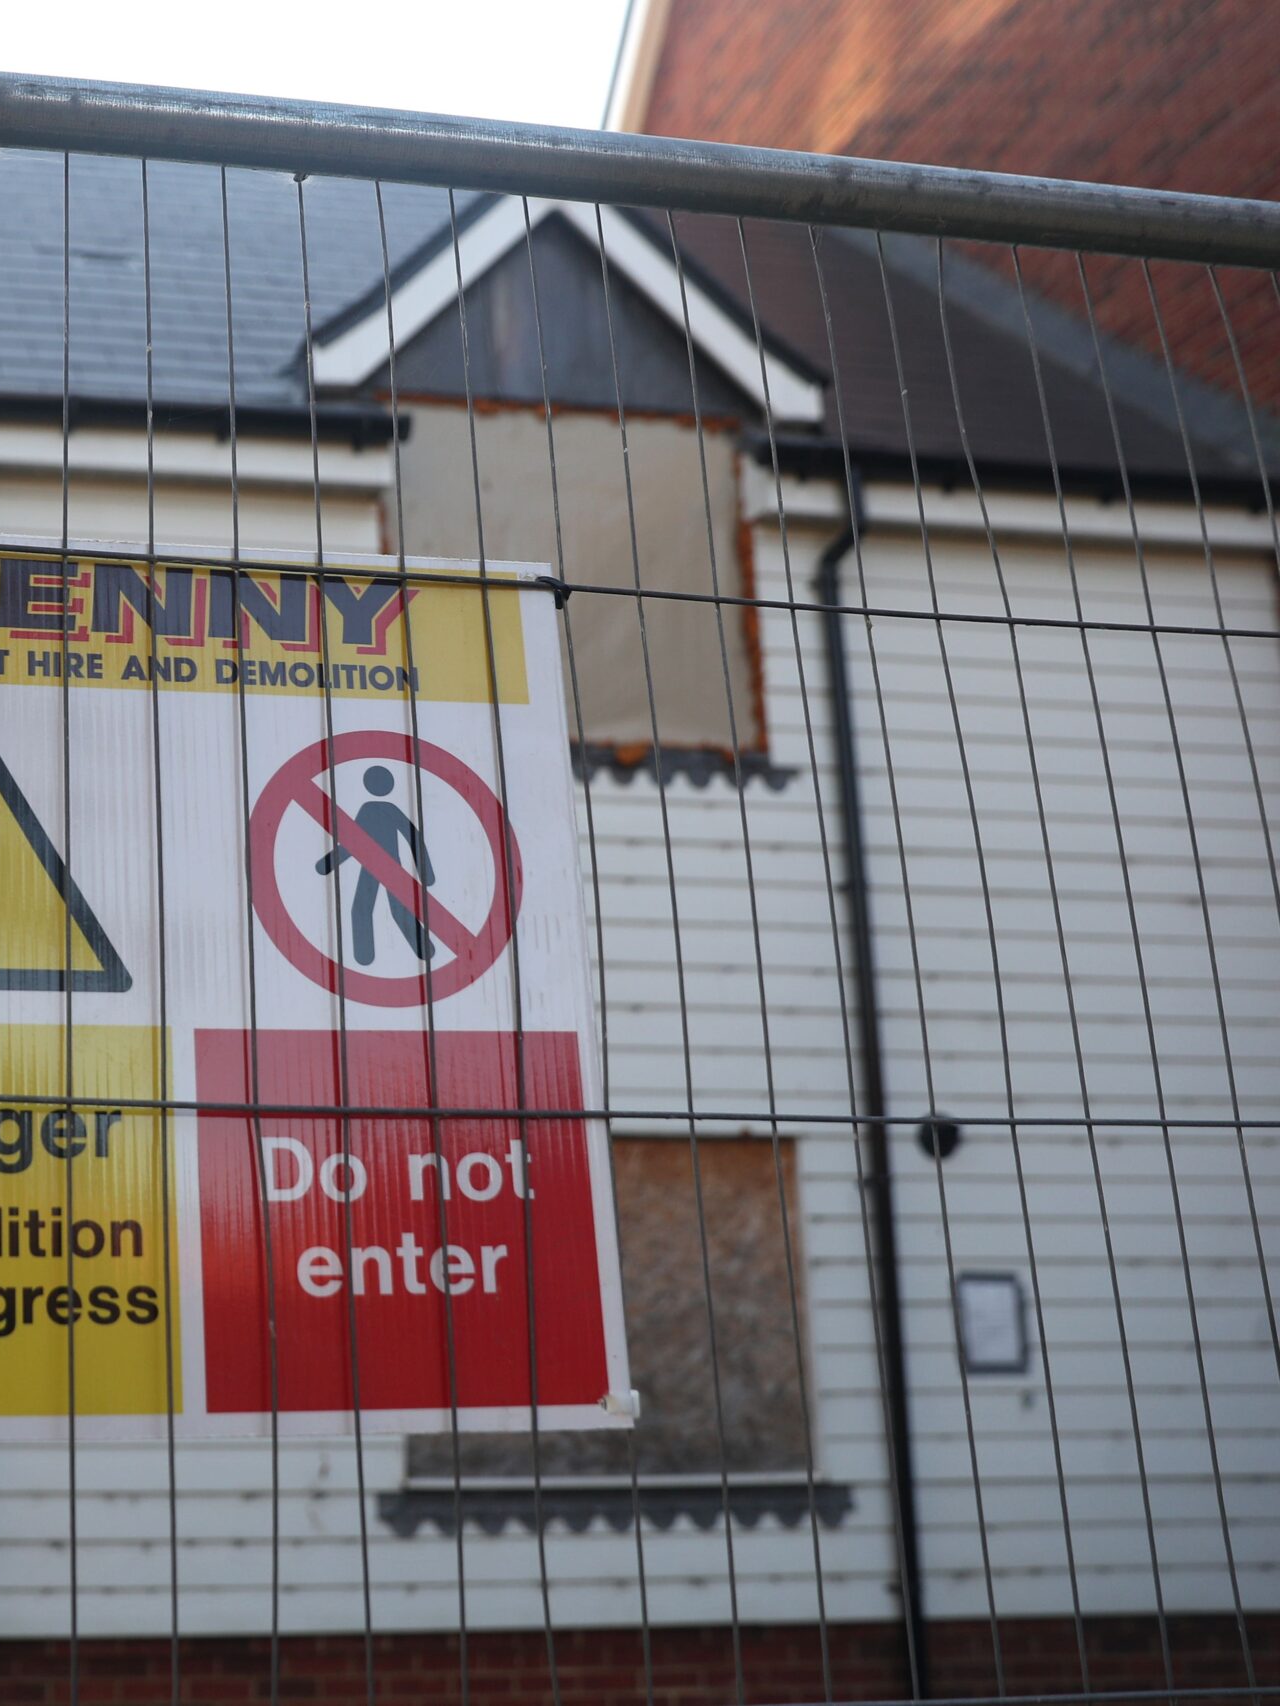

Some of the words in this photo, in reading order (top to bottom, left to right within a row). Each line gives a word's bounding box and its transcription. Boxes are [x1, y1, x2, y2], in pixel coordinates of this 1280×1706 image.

[27, 650, 104, 680] HIRE
[121, 655, 198, 684] AND
[215, 658, 419, 692] DEMOLITION
[261, 1136, 368, 1203] Do
[408, 1138, 535, 1202] not
[296, 1232, 508, 1298] enter
